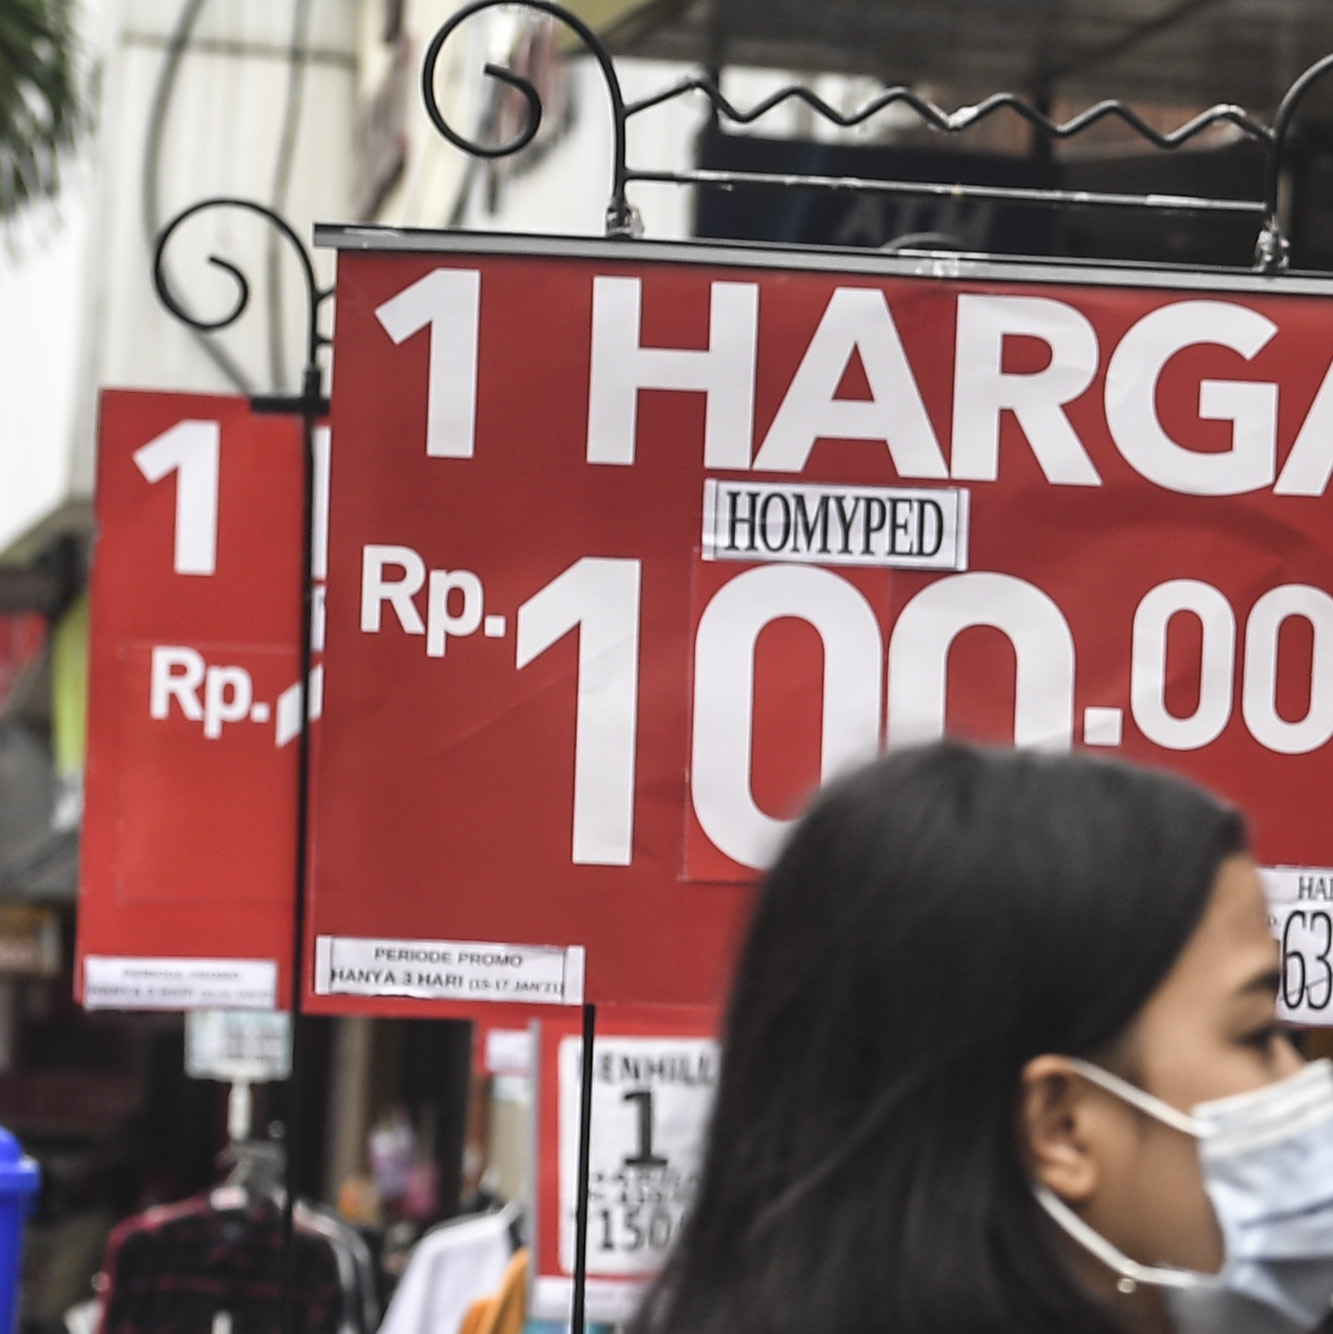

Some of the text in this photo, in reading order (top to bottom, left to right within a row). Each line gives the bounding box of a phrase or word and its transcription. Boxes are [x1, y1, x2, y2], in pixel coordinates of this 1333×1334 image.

[376, 269, 480, 457] 1
[134, 421, 219, 575] 1
[726, 491, 944, 558] HOMYPED
[361, 545, 505, 657] Rp.
[151, 646, 269, 738] Rp.
[332, 967, 396, 985] HANYA
[402, 972, 413, 986] 3
[419, 974, 463, 988] HARI
[375, 948, 523, 966] PERIODE PROMO
[625, 1092, 667, 1167] 1
